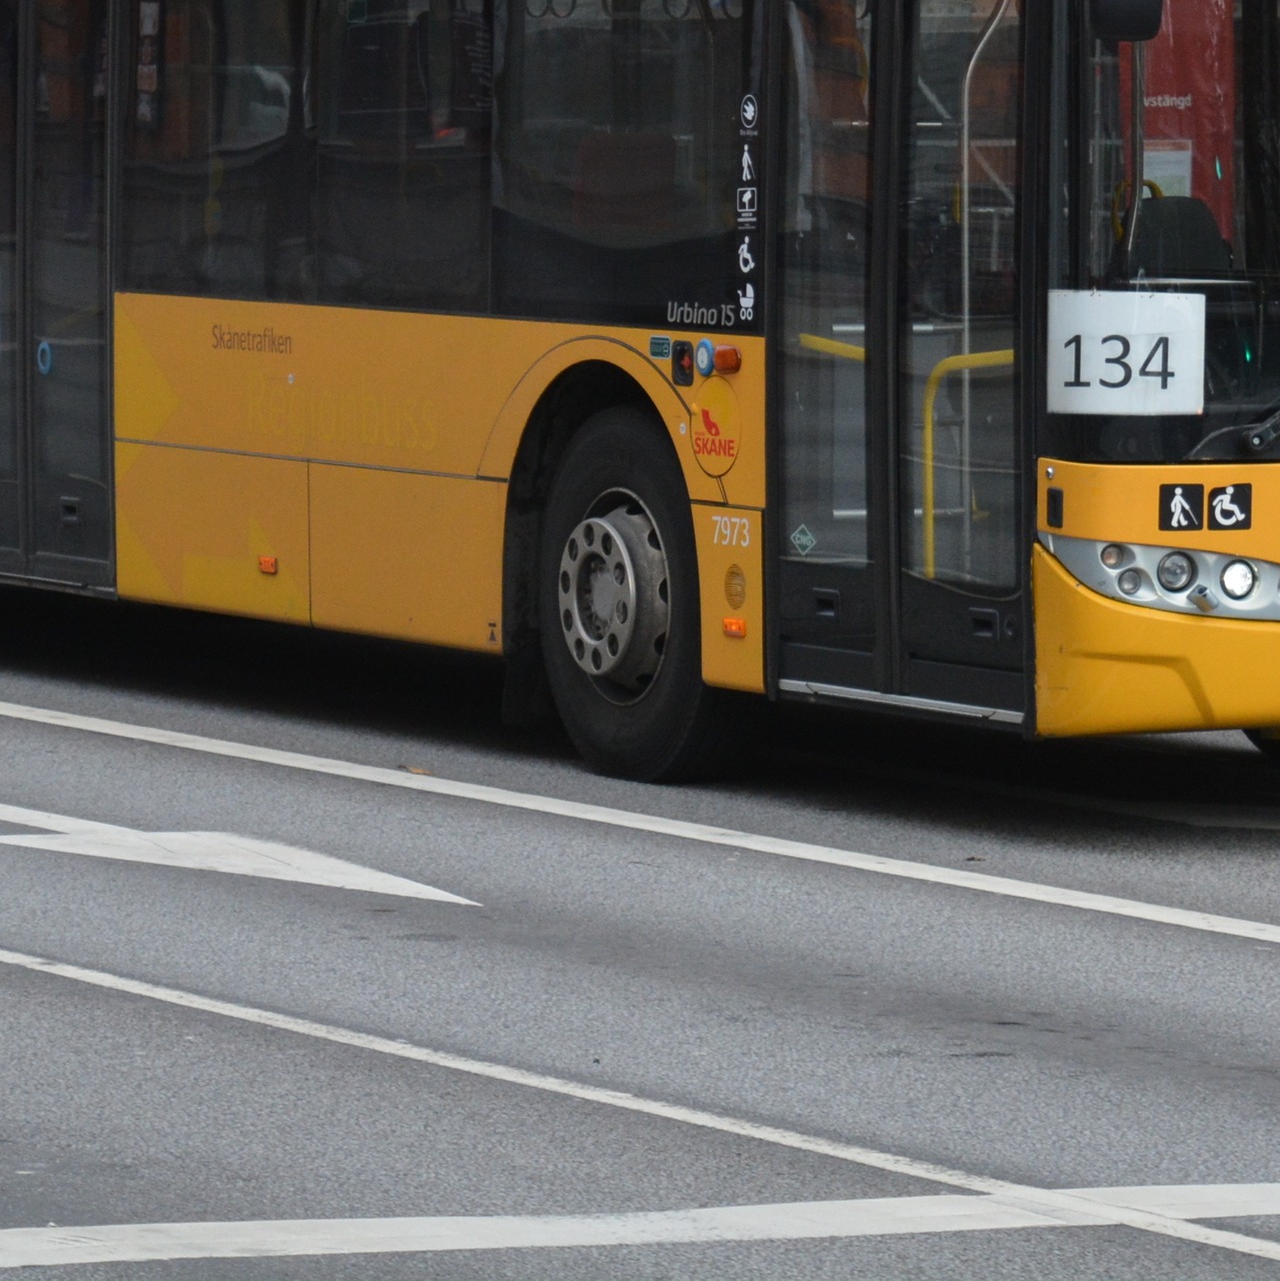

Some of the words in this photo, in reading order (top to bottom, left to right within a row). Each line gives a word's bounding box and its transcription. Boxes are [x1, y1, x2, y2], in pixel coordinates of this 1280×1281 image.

[1143, 93, 1192, 110] vstängd
[667, 301, 717, 325] Urbino
[721, 304, 736, 327] 15
[212, 324, 292, 355] Skånetrafiken
[1062, 333, 1176, 391] 134
[712, 516, 750, 547] 7973
[795, 533, 813, 548] CNG
